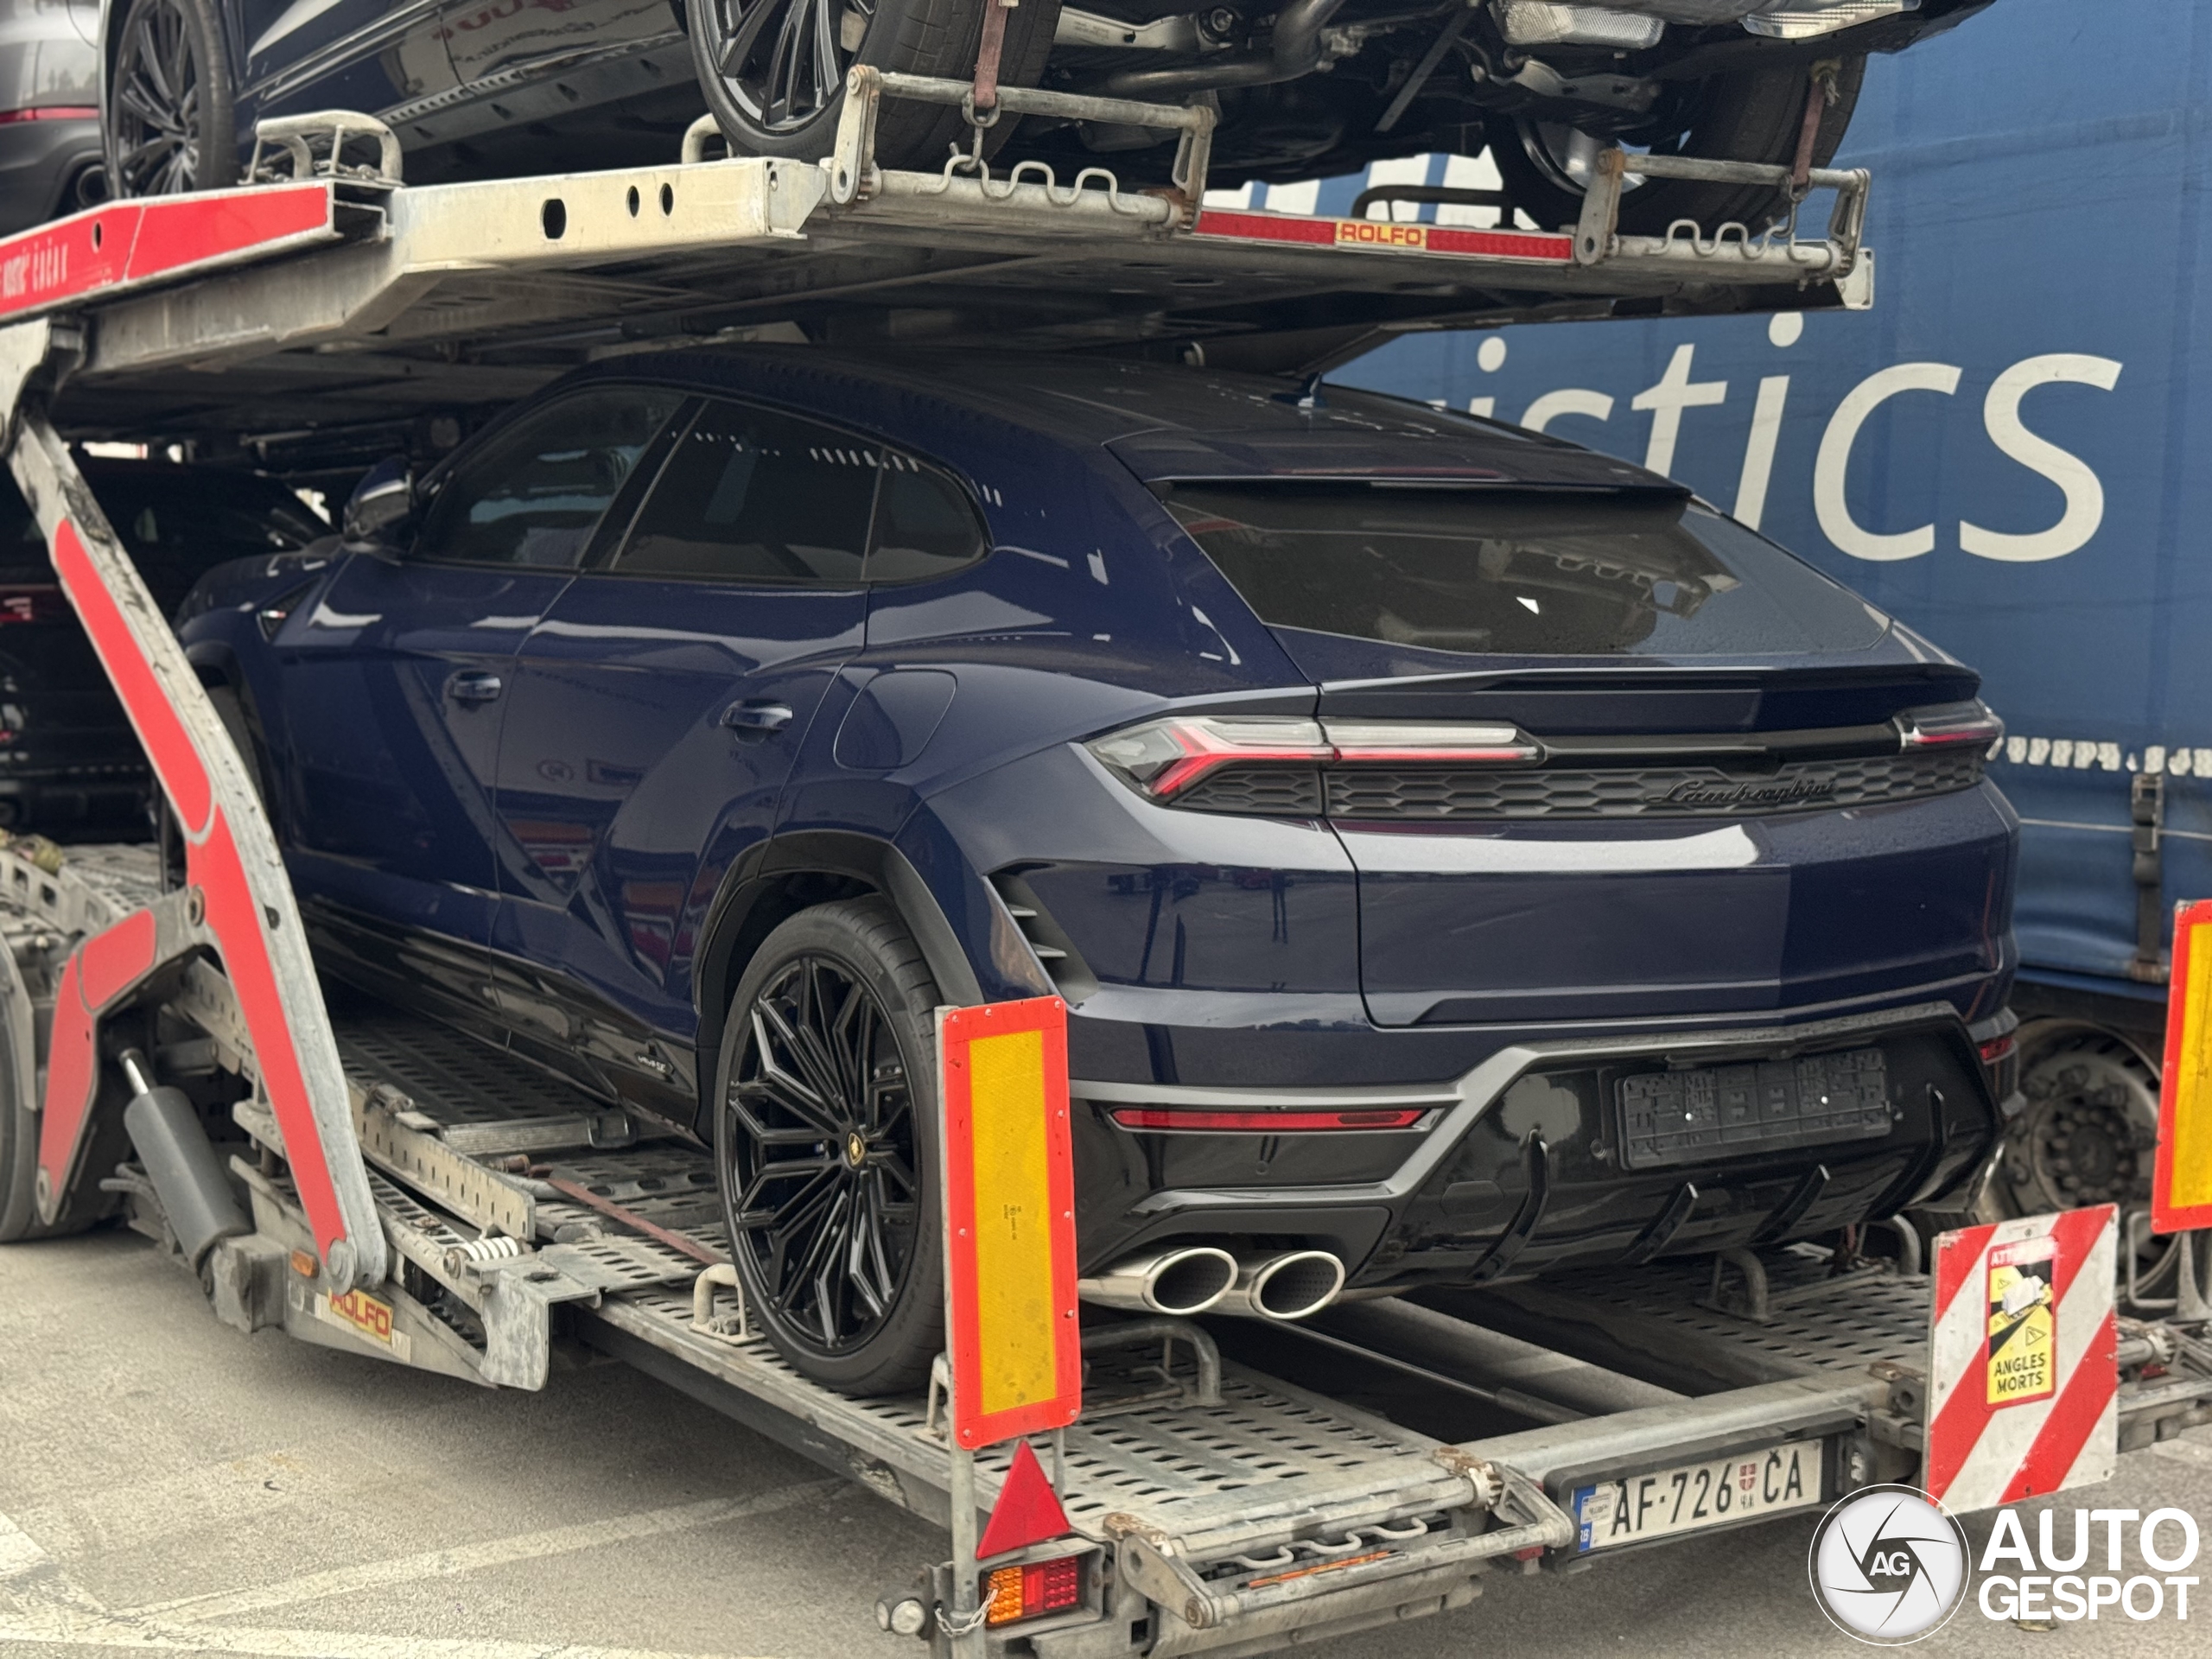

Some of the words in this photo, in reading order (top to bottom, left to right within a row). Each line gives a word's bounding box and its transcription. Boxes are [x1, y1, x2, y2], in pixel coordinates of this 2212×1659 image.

[1340, 223, 1421, 245] ROLFO
[1993, 1352, 2046, 1377] ANGLES
[1996, 1371, 2044, 1395] MORTS
